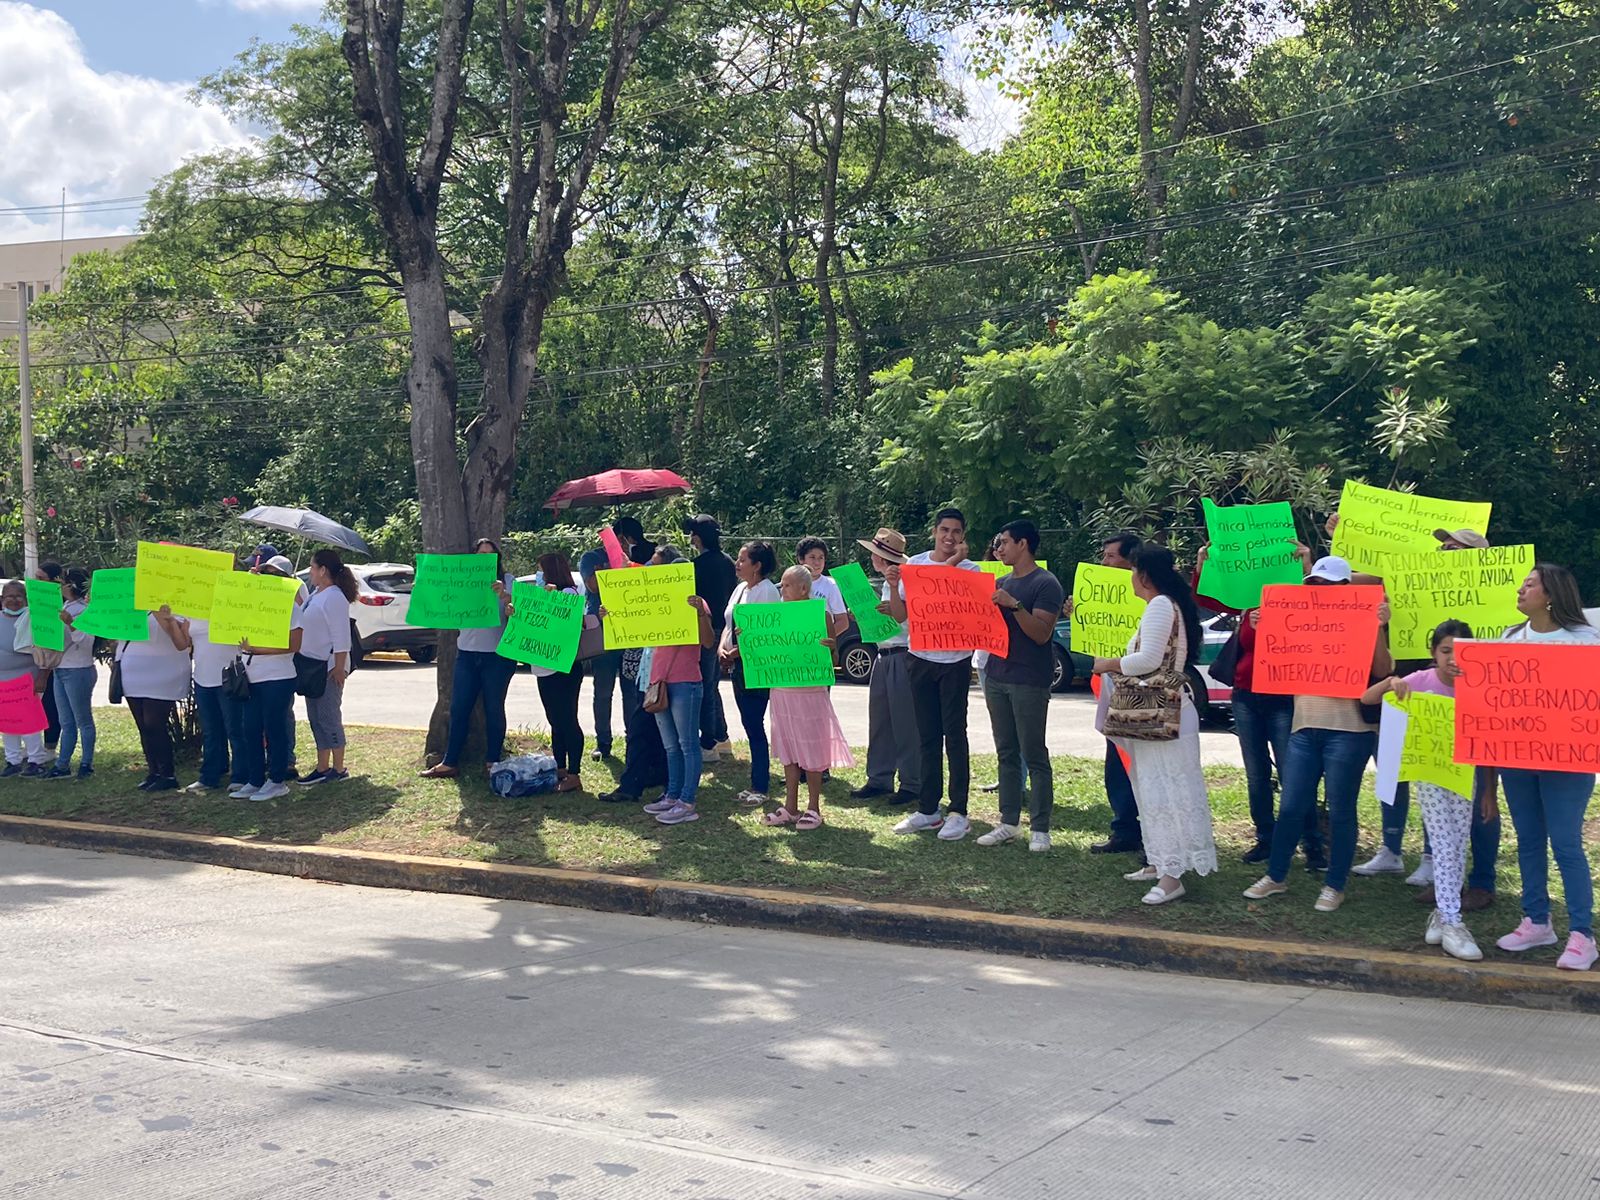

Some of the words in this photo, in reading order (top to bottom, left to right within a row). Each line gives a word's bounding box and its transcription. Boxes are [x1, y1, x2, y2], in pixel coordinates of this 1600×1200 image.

[1345, 482, 1402, 511] Verónica
[1380, 511, 1434, 537] Giadia
[1335, 542, 1355, 561] SU
[1386, 552, 1446, 572] VENIMOS
[1450, 549, 1474, 569] CON
[1478, 545, 1527, 567] RESPETO
[641, 567, 695, 587] Hernández
[1079, 567, 1130, 605] SEÑOR
[1404, 571, 1454, 592] PEDIMOS
[1458, 570, 1475, 589] SU
[1479, 568, 1516, 588] AYUDA
[622, 588, 671, 605] Giadians
[1263, 586, 1309, 609] Verónica
[1310, 591, 1374, 611] Hernández
[1431, 589, 1487, 608] FISCAL
[524, 611, 551, 630] FISCAL
[607, 606, 652, 627] pedimos
[911, 621, 965, 633] PEDIMOS
[977, 621, 992, 633] SU
[1074, 602, 1142, 632] GOBERNADO
[1284, 613, 1346, 632] Giadians
[612, 626, 691, 645] Intervensión
[1265, 633, 1313, 654] Pedimos
[743, 651, 795, 668] PEDIMOS
[802, 652, 819, 666] SU
[1081, 640, 1127, 658] INTERV
[1460, 645, 1542, 689] SEÑOR
[1484, 686, 1600, 712] GOBERNADO
[1461, 713, 1547, 735] PEDIMOS
[1570, 715, 1599, 735] SU
[1404, 735, 1422, 751] UE
[1461, 736, 1600, 764] INTERVENCI
